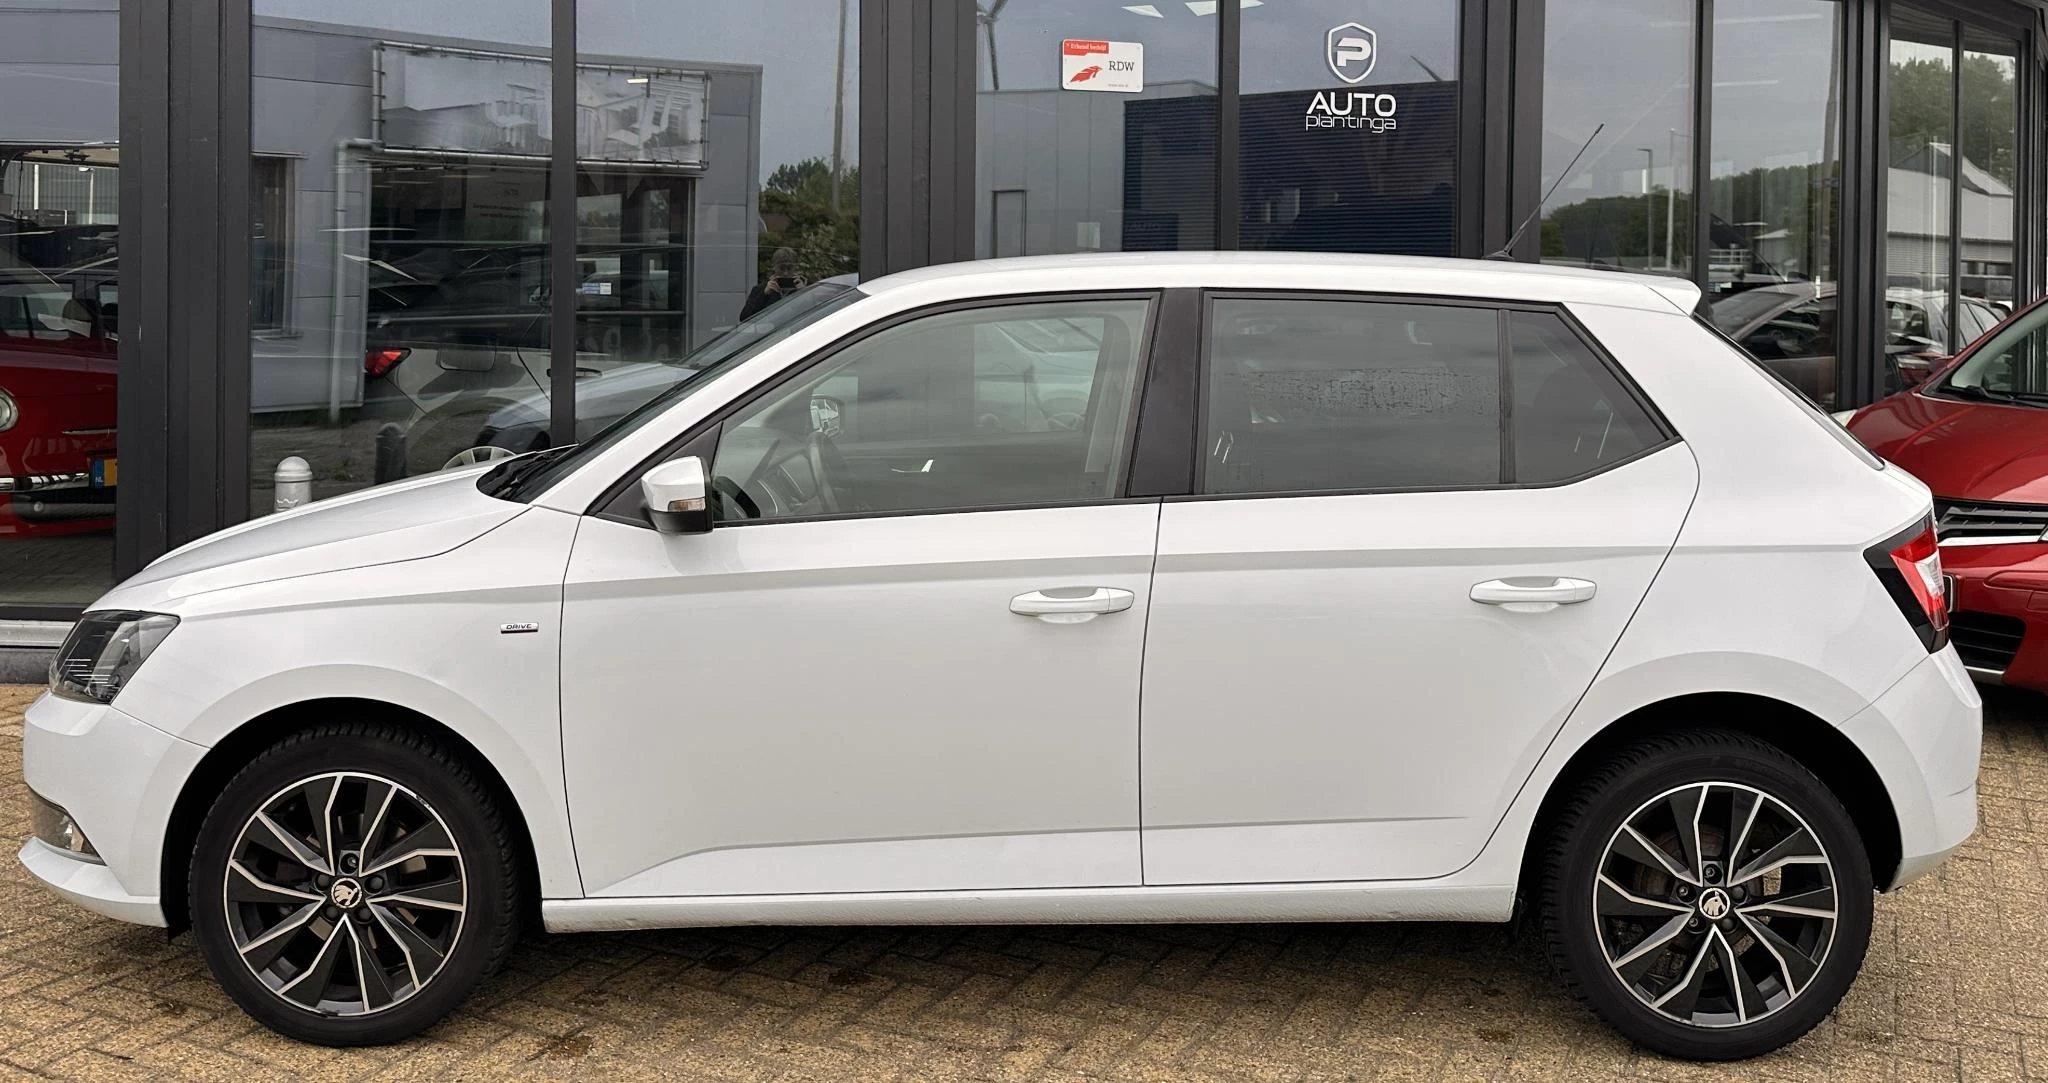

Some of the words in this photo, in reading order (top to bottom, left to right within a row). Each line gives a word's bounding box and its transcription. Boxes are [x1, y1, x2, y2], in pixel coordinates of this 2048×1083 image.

[1108, 60, 1135, 72] RDW
[1306, 91, 1397, 117] AUTO
[1305, 113, 1397, 134] plantinga
